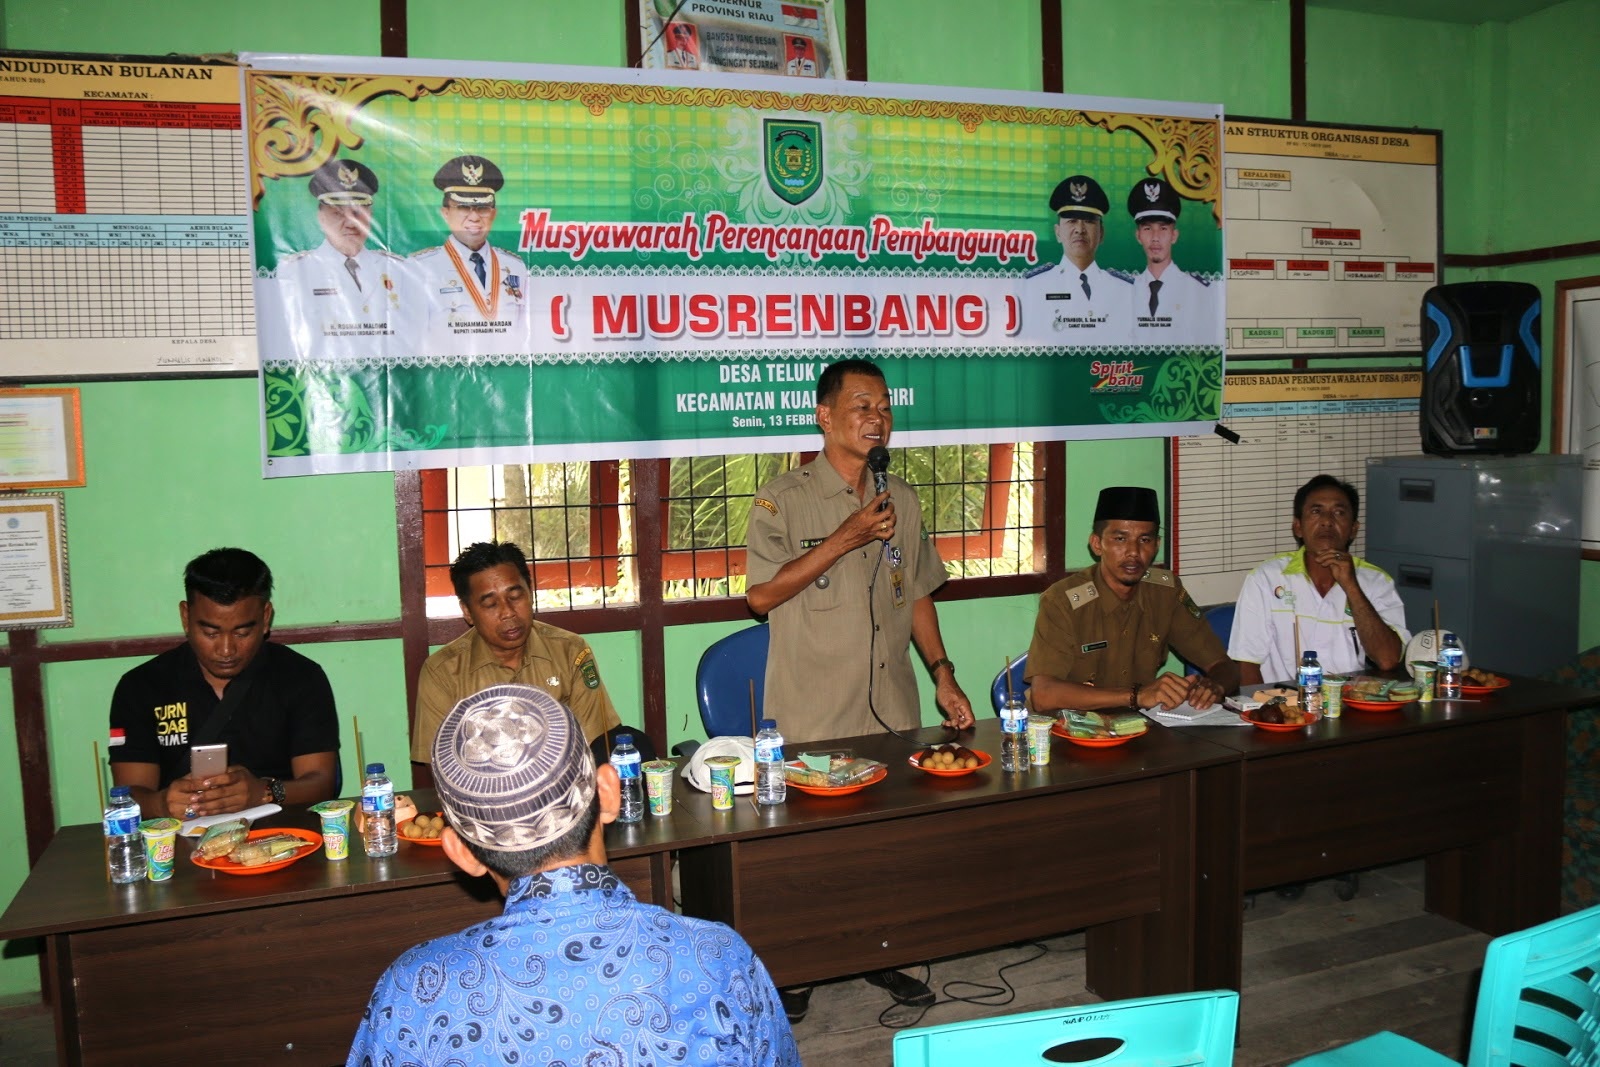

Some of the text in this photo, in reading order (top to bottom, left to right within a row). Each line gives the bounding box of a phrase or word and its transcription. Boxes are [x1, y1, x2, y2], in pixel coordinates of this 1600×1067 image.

[692, 3, 775, 22] PROVINSI RIAU
[706, 32, 777, 46] BANGSA YANG BESAR
[120, 65, 213, 80] BULANAN
[749, 60, 779, 71] SEJARAH
[83, 90, 148, 99] KECAMATAN
[57, 107, 76, 117] USIA
[1247, 127, 1309, 140] STRUKTUR
[1311, 132, 1379, 145] ORGANISASI
[1381, 137, 1409, 147] DESA
[522, 212, 1037, 263] Musyawarah Perencanaan Pembangunan
[592, 294, 984, 336] MUSRENBANG
[719, 364, 762, 384] DESA
[765, 362, 816, 383] TELUK
[1090, 361, 1134, 378] Spirit
[1107, 372, 1144, 387] baru
[1259, 375, 1290, 385] BADAN
[1291, 374, 1378, 384] PERMUSYAWARATAN
[1379, 373, 1400, 383] DESA
[676, 391, 775, 413] KECAMATAN
[732, 416, 766, 429] Senin,
[769, 415, 782, 426] 13
[157, 733, 188, 746] RIME
